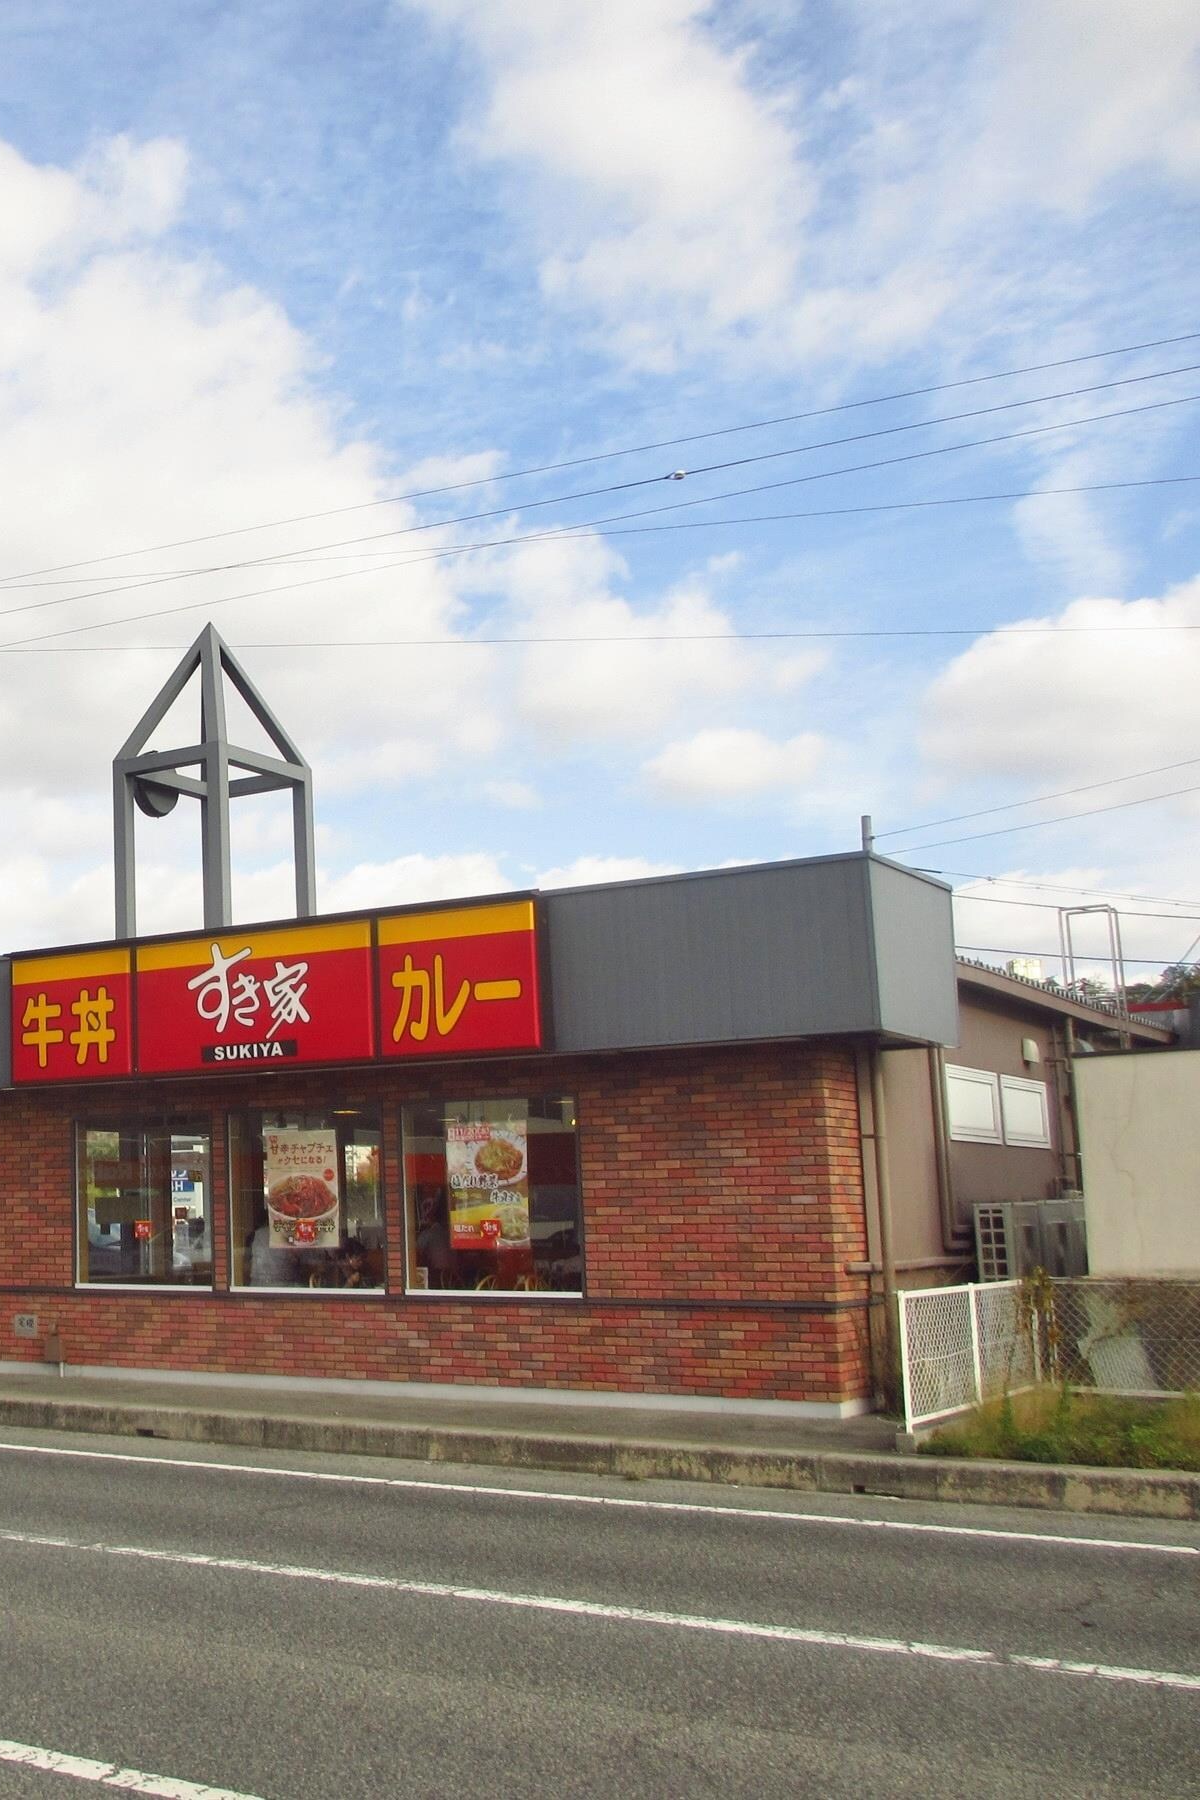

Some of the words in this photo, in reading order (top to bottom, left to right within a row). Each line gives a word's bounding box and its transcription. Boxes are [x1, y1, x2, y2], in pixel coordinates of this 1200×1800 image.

[22, 986, 116, 1068] 牛丼
[187, 942, 311, 1039] すき家
[392, 953, 522, 1042] カレー
[213, 1041, 284, 1061] SUKIYA
